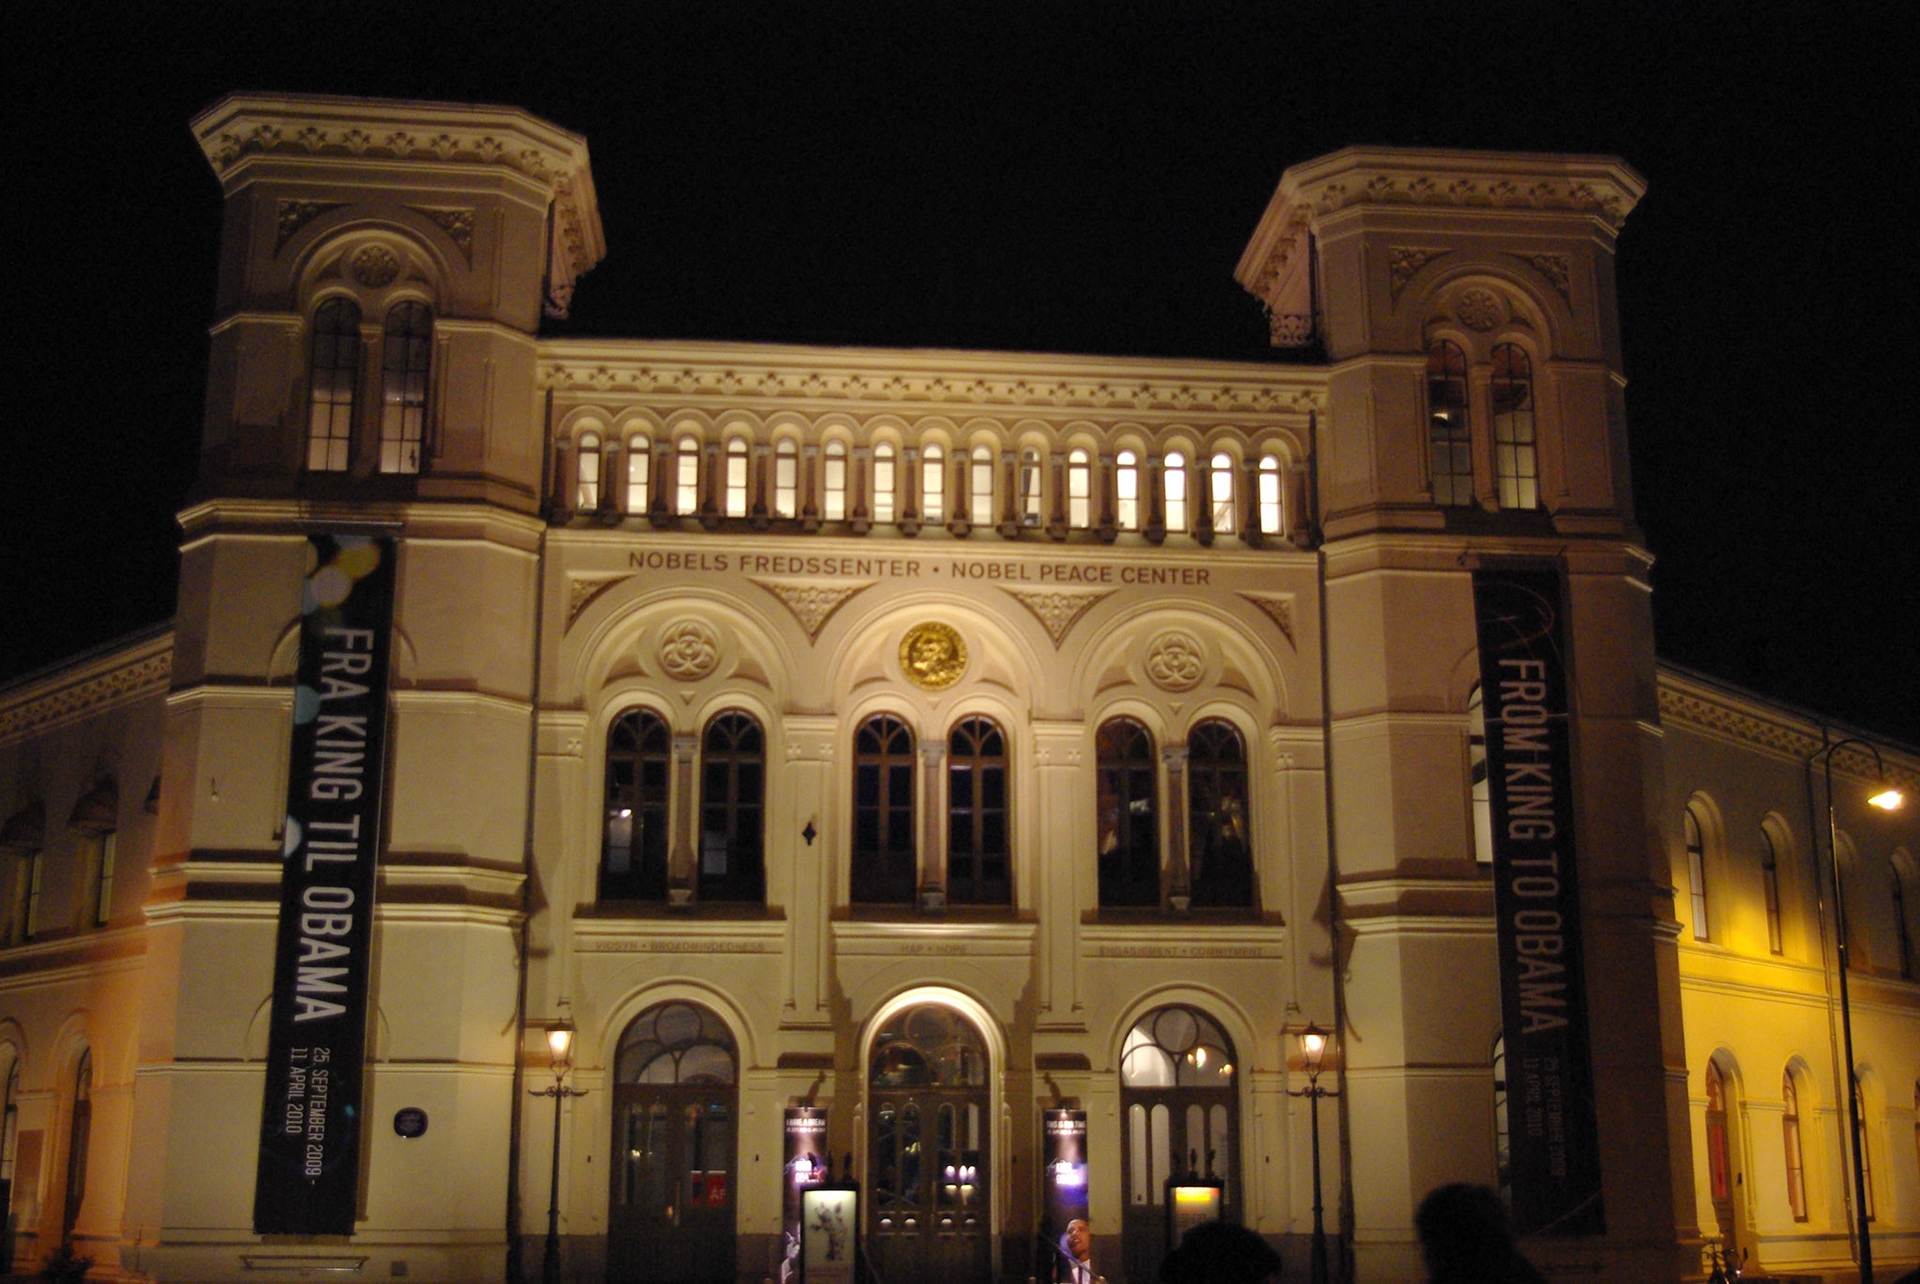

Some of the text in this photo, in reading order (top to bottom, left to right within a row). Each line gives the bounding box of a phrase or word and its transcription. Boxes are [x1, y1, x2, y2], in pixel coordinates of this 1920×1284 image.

[628, 551, 1210, 586] NOBELS FREDSSENTER NOBEL PEACE CENTER
[294, 627, 374, 1022] FRA KING TIL OBAMA
[1498, 658, 1569, 1035] FROM KING TO OBAMA
[285, 1046, 308, 1133] 11. APRIL 2010
[313, 1046, 331, 1066] 25.
[1524, 1072, 1543, 1104] APRIL
[307, 1069, 330, 1141] SEPTEMBER
[1544, 1074, 1564, 1142] SEPTEMBER
[305, 1144, 323, 1176] 2009
